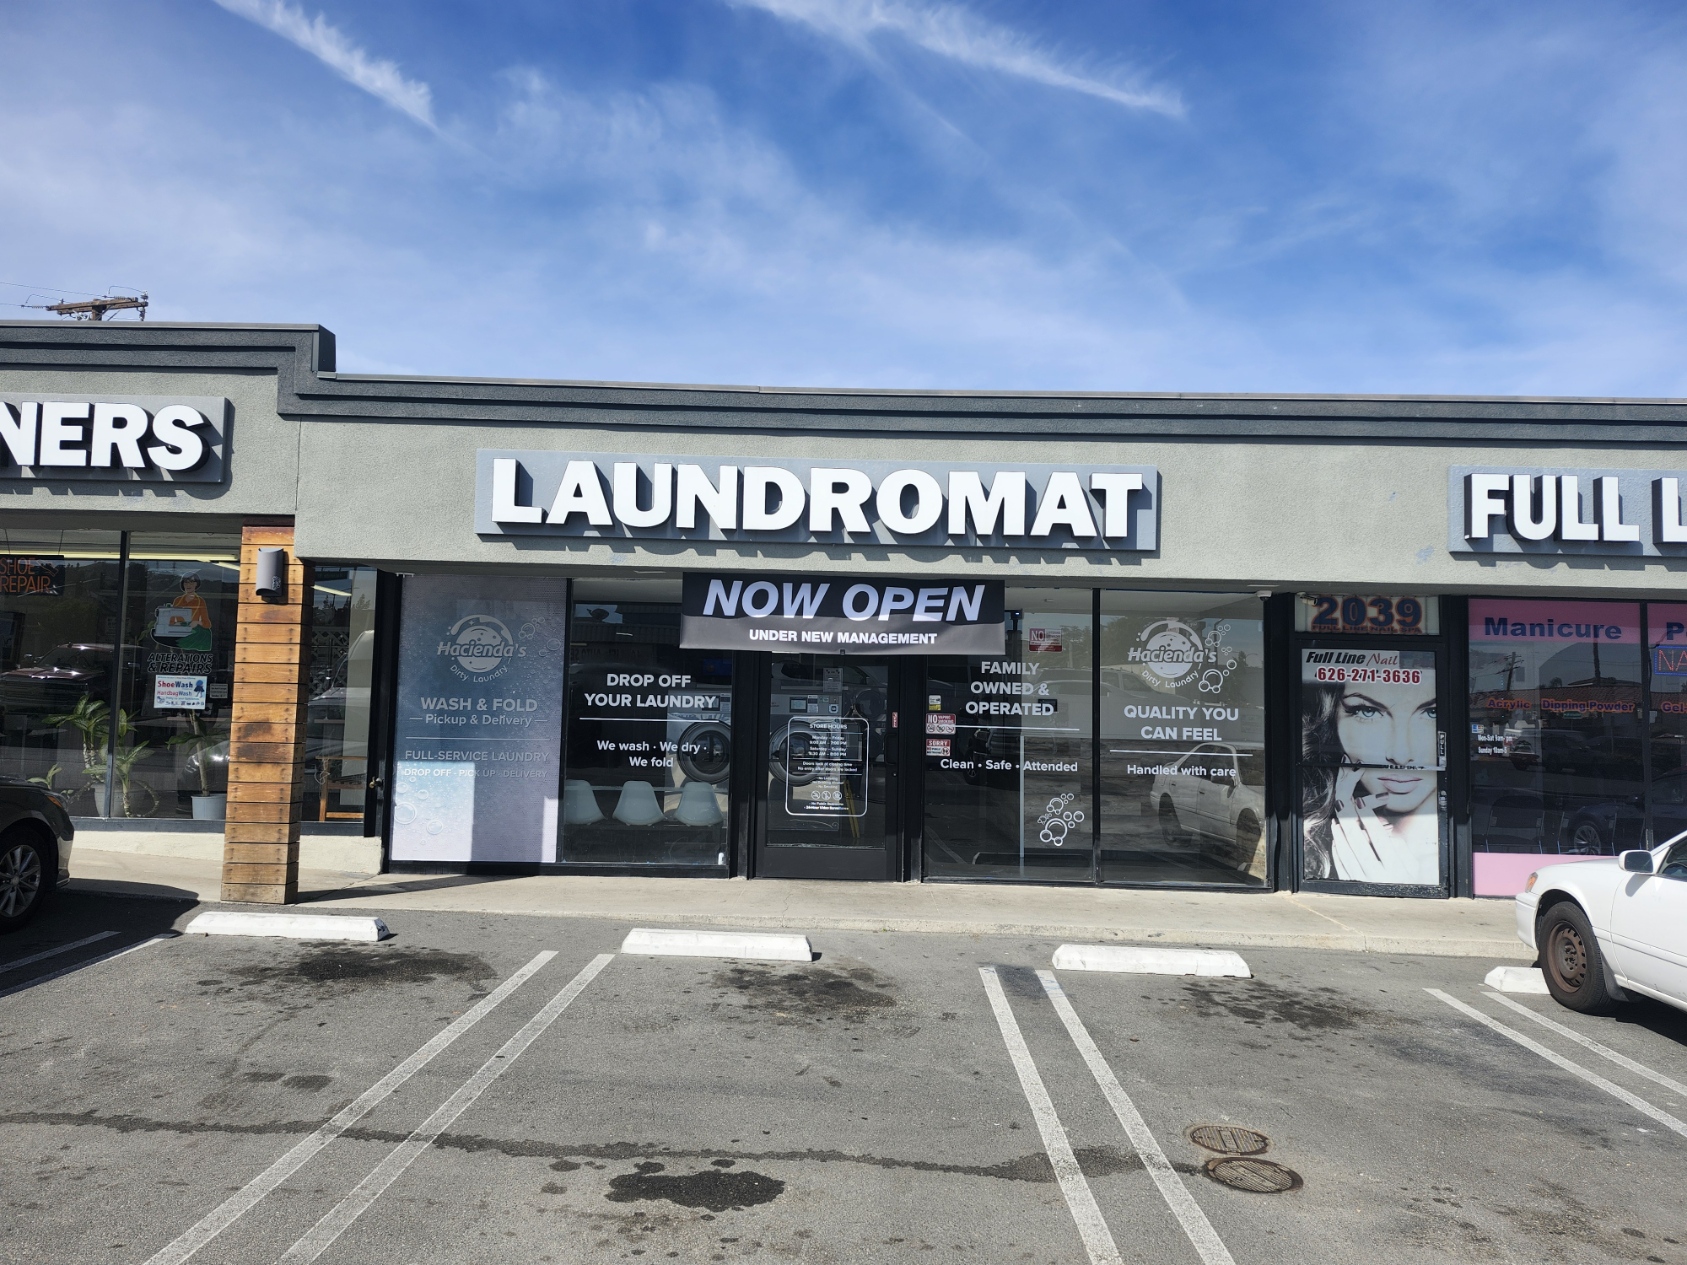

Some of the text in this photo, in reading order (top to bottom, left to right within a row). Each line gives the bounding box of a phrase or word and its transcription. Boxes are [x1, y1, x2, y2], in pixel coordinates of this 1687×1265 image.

[0, 401, 204, 471] NERS
[491, 458, 1143, 538] LAUNDROMAT
[1467, 473, 1640, 542] FULL
[0, 557, 36, 575] SHOE
[0, 575, 51, 593] REPAIR
[702, 579, 986, 622] NOW OPEN
[1311, 594, 1422, 628] 2039
[1031, 630, 1045, 641] NO
[1484, 616, 1622, 640] Manicure
[749, 629, 938, 645] UNDER NEW MANAGEMENT
[437, 641, 527, 657] Hacienda's
[1127, 646, 1217, 663] Hacienda's
[148, 652, 213, 663] ALTERATIONS
[1306, 652, 1398, 666] Full Line Nail
[148, 662, 212, 674] & REPAIRS
[450, 664, 508, 683] Dirty Laundry
[981, 661, 1040, 675] FAMILY
[1317, 667, 1421, 684] 626-271-3636
[157, 680, 193, 689] ShoeWash
[606, 673, 691, 687] DROP OFF
[1141, 670, 1199, 688] Dirty Laundry
[970, 681, 1049, 696] OWNED &
[421, 697, 538, 712] WASH & FOLD
[584, 693, 716, 709] YOUR LAUNDRY
[965, 701, 1054, 716] OPERATED
[1487, 698, 1531, 711] Acrylic
[1541, 698, 1588, 713] Dipping
[1589, 700, 1635, 713] Powder
[425, 714, 532, 727] Pickup & Delivery
[927, 714, 938, 724] NO
[1123, 705, 1239, 721] QUALITY YOU
[1140, 726, 1222, 741] CAN FEEL
[597, 740, 700, 754] We wash We dry
[405, 751, 549, 762] FULL-SERVICE LAUNDRY
[629, 756, 674, 768] We fold
[404, 768, 431, 776] DROP
[433, 768, 452, 776] OFF
[458, 769, 480, 777] PICK
[503, 770, 548, 778] DELIVERY
[940, 759, 1078, 772] Clean Safe Attended
[1127, 765, 1237, 776] Handled with care
